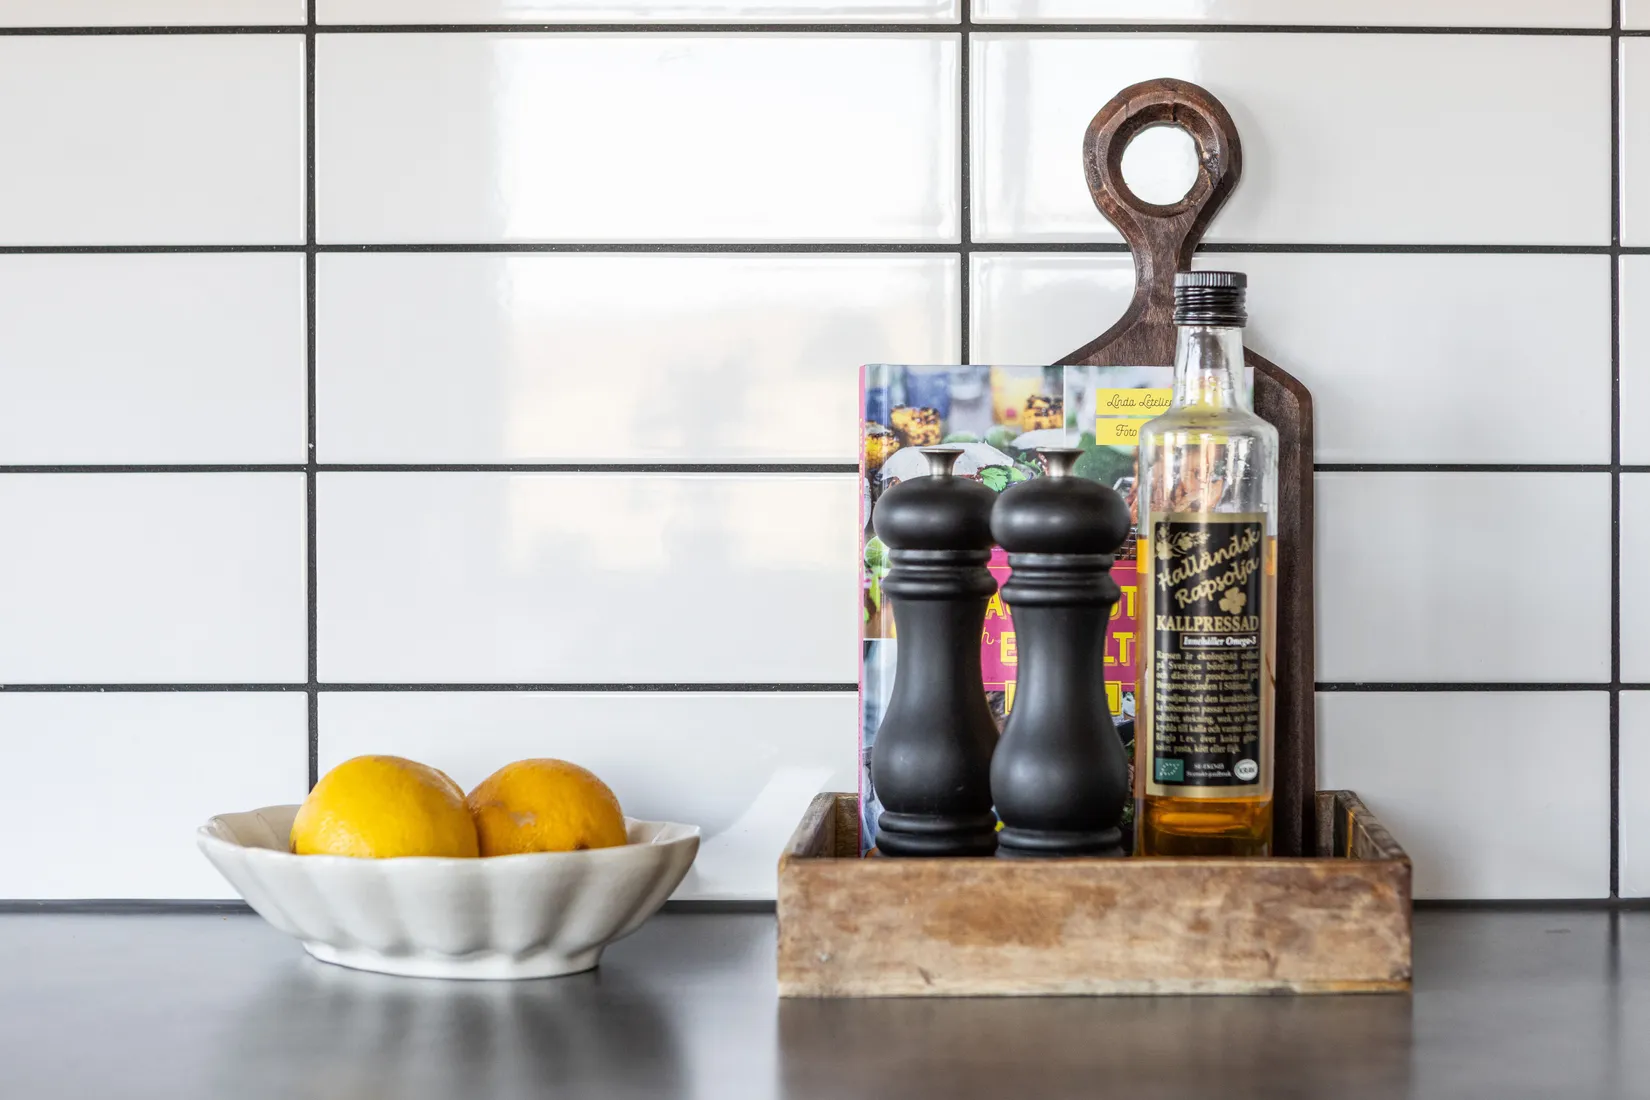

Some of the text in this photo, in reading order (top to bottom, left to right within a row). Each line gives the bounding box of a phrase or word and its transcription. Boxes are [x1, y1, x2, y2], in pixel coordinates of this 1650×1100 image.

[1107, 394, 1136, 409] Linda
[1116, 424, 1138, 437] Foto
[1175, 558, 1260, 609] Rapsolja
[1156, 614, 1260, 632] KALLPRESSAD
[1225, 636, 1257, 648] Omega-3
